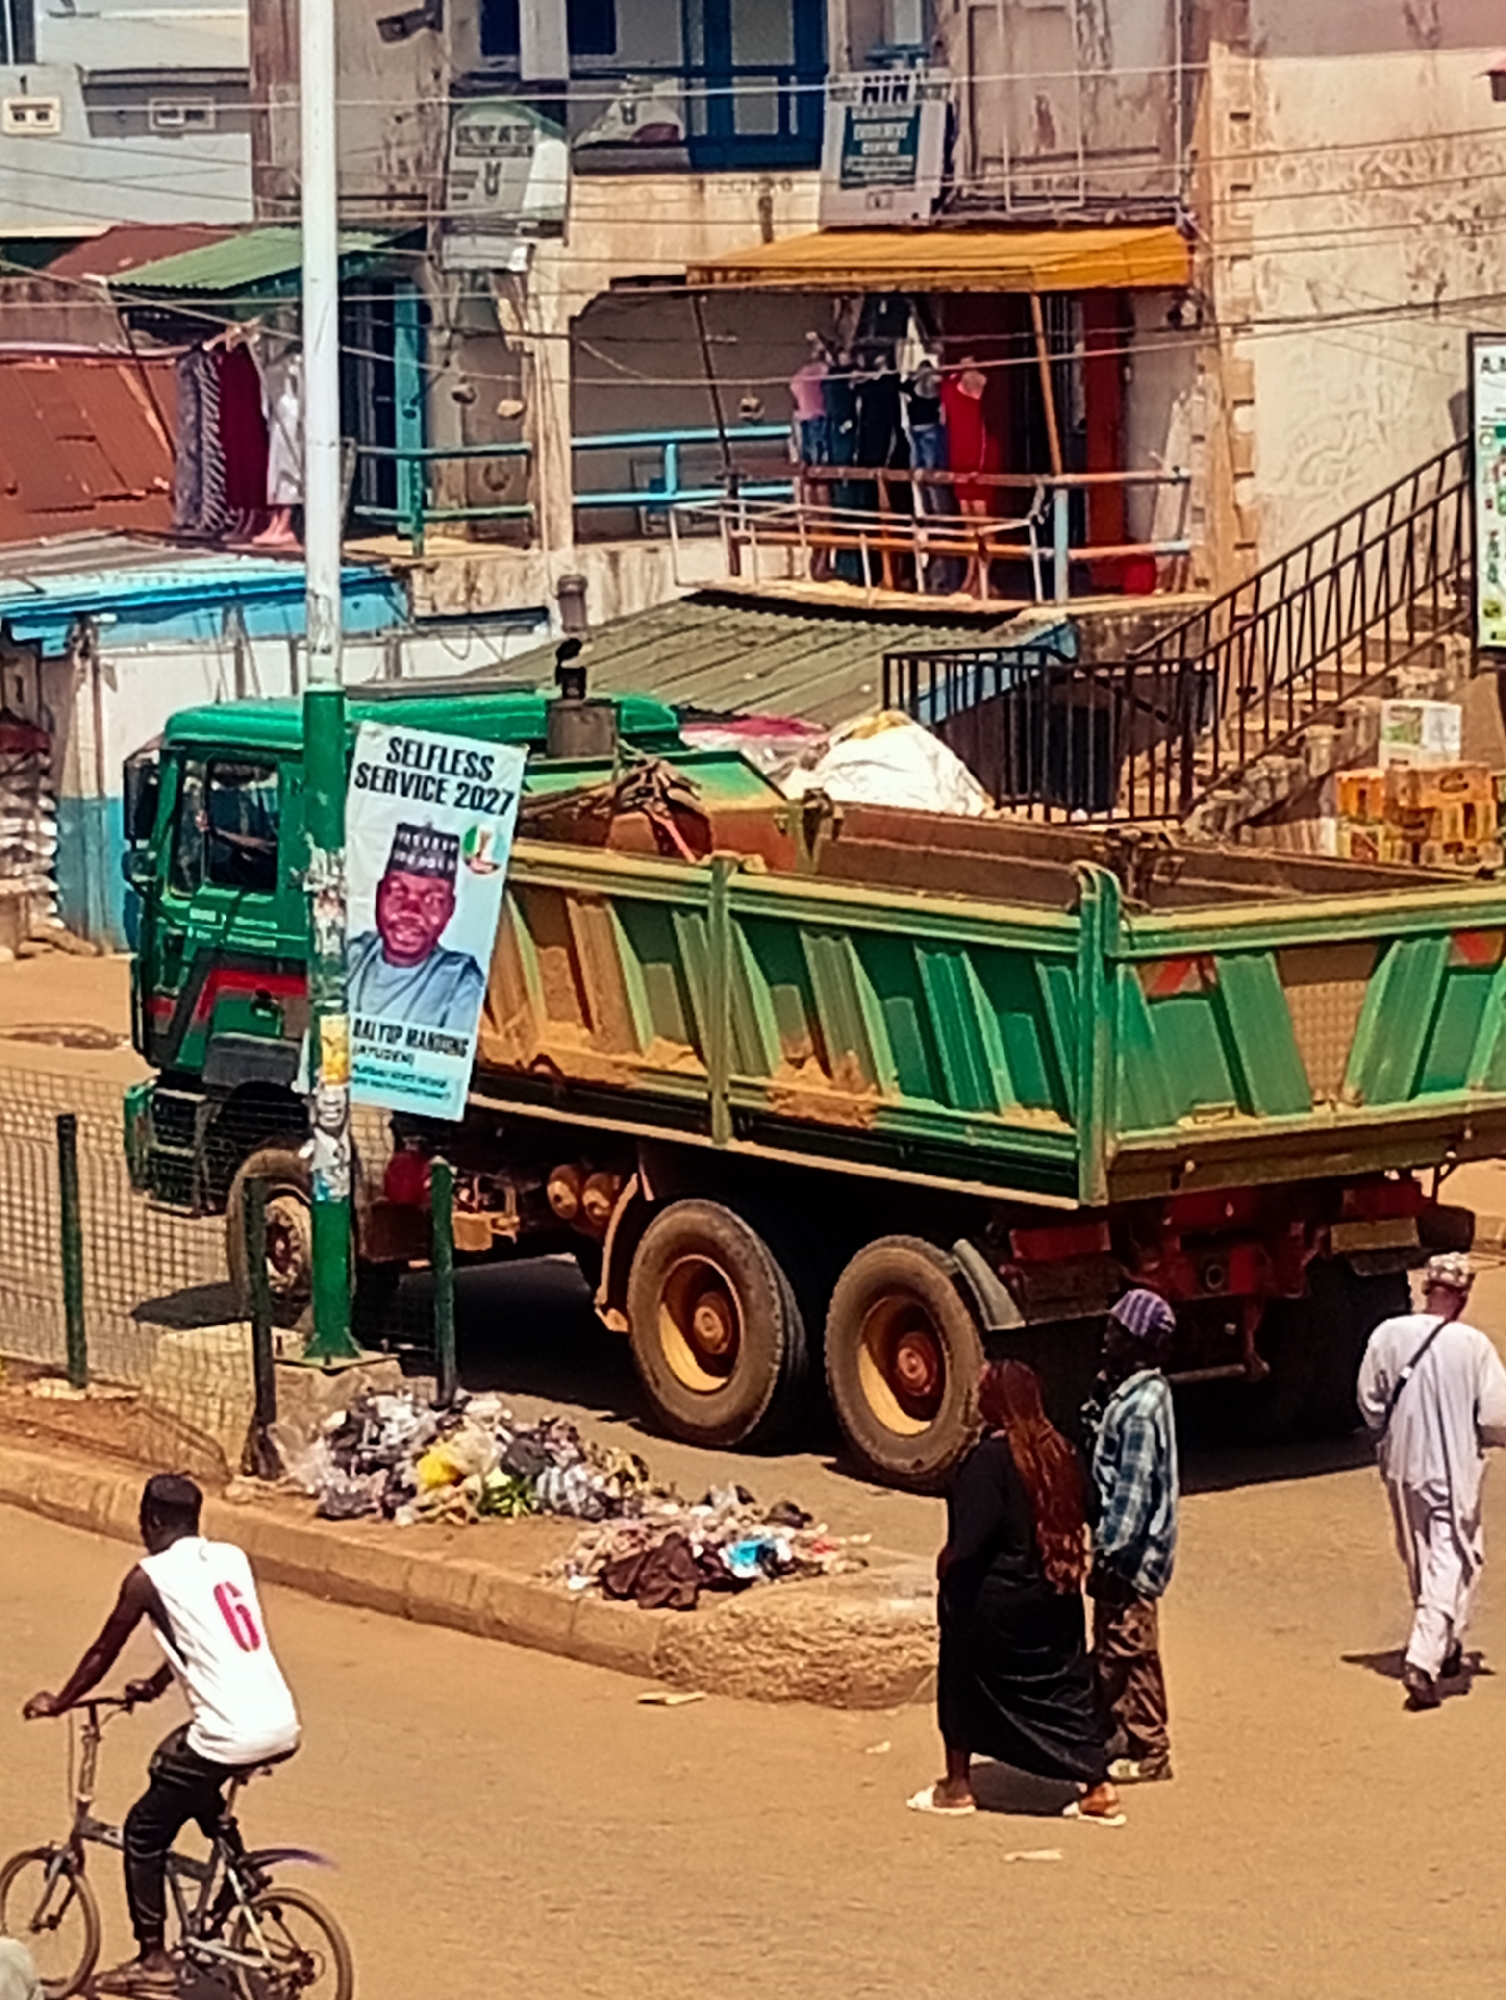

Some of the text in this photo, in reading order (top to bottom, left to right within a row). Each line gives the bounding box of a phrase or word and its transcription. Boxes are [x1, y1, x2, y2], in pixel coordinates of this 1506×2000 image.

[386, 737, 495, 782] SELFLESS
[354, 762, 515, 816] SERVICE 2027
[212, 1580, 261, 1653] 6
